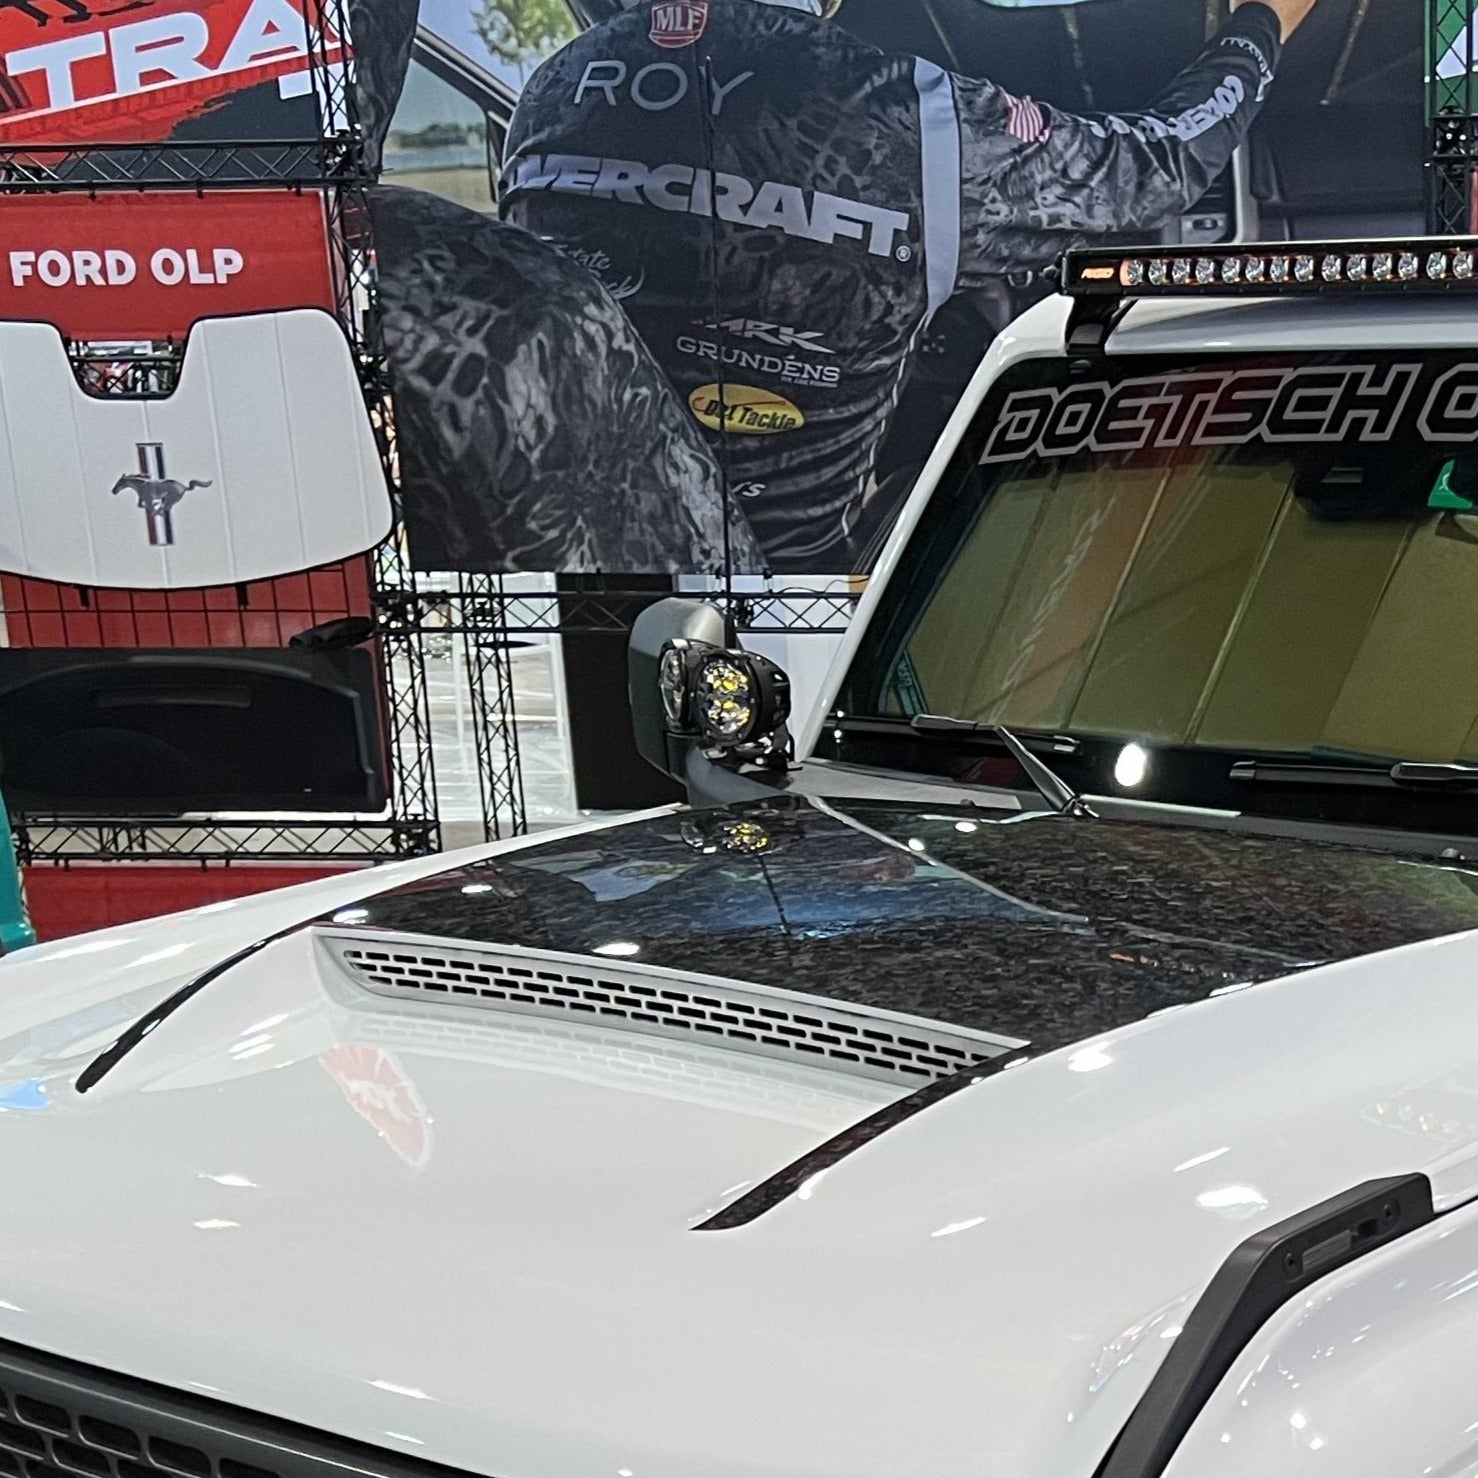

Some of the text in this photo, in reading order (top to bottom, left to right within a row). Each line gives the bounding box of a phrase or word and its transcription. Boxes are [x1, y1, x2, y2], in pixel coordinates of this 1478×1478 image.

[656, 6, 702, 32] MLF
[573, 59, 755, 115] ROY
[9, 248, 244, 287] FORD OLP
[978, 362, 1425, 466] DOETSCH
